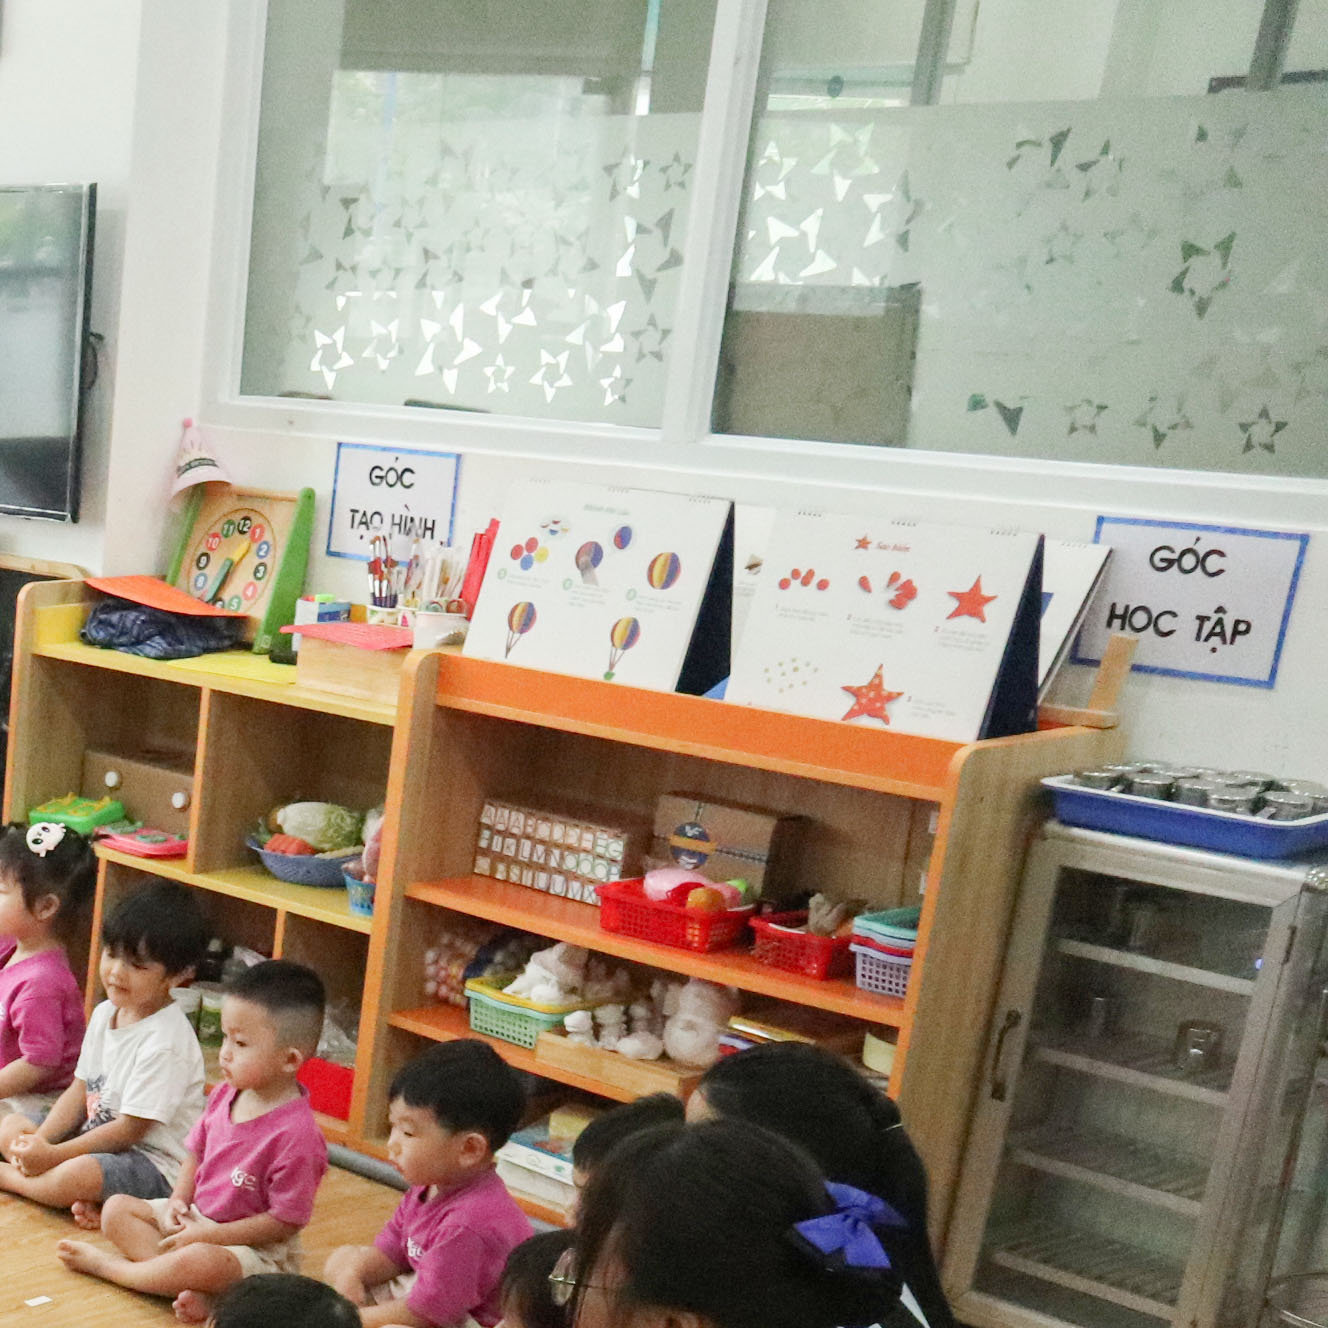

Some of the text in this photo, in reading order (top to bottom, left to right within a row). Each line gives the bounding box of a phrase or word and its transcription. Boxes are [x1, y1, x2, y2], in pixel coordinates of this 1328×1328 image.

[369, 456, 416, 489] GÓC
[1148, 536, 1227, 578] GÓC
[1194, 606, 1252, 654] TẬP
